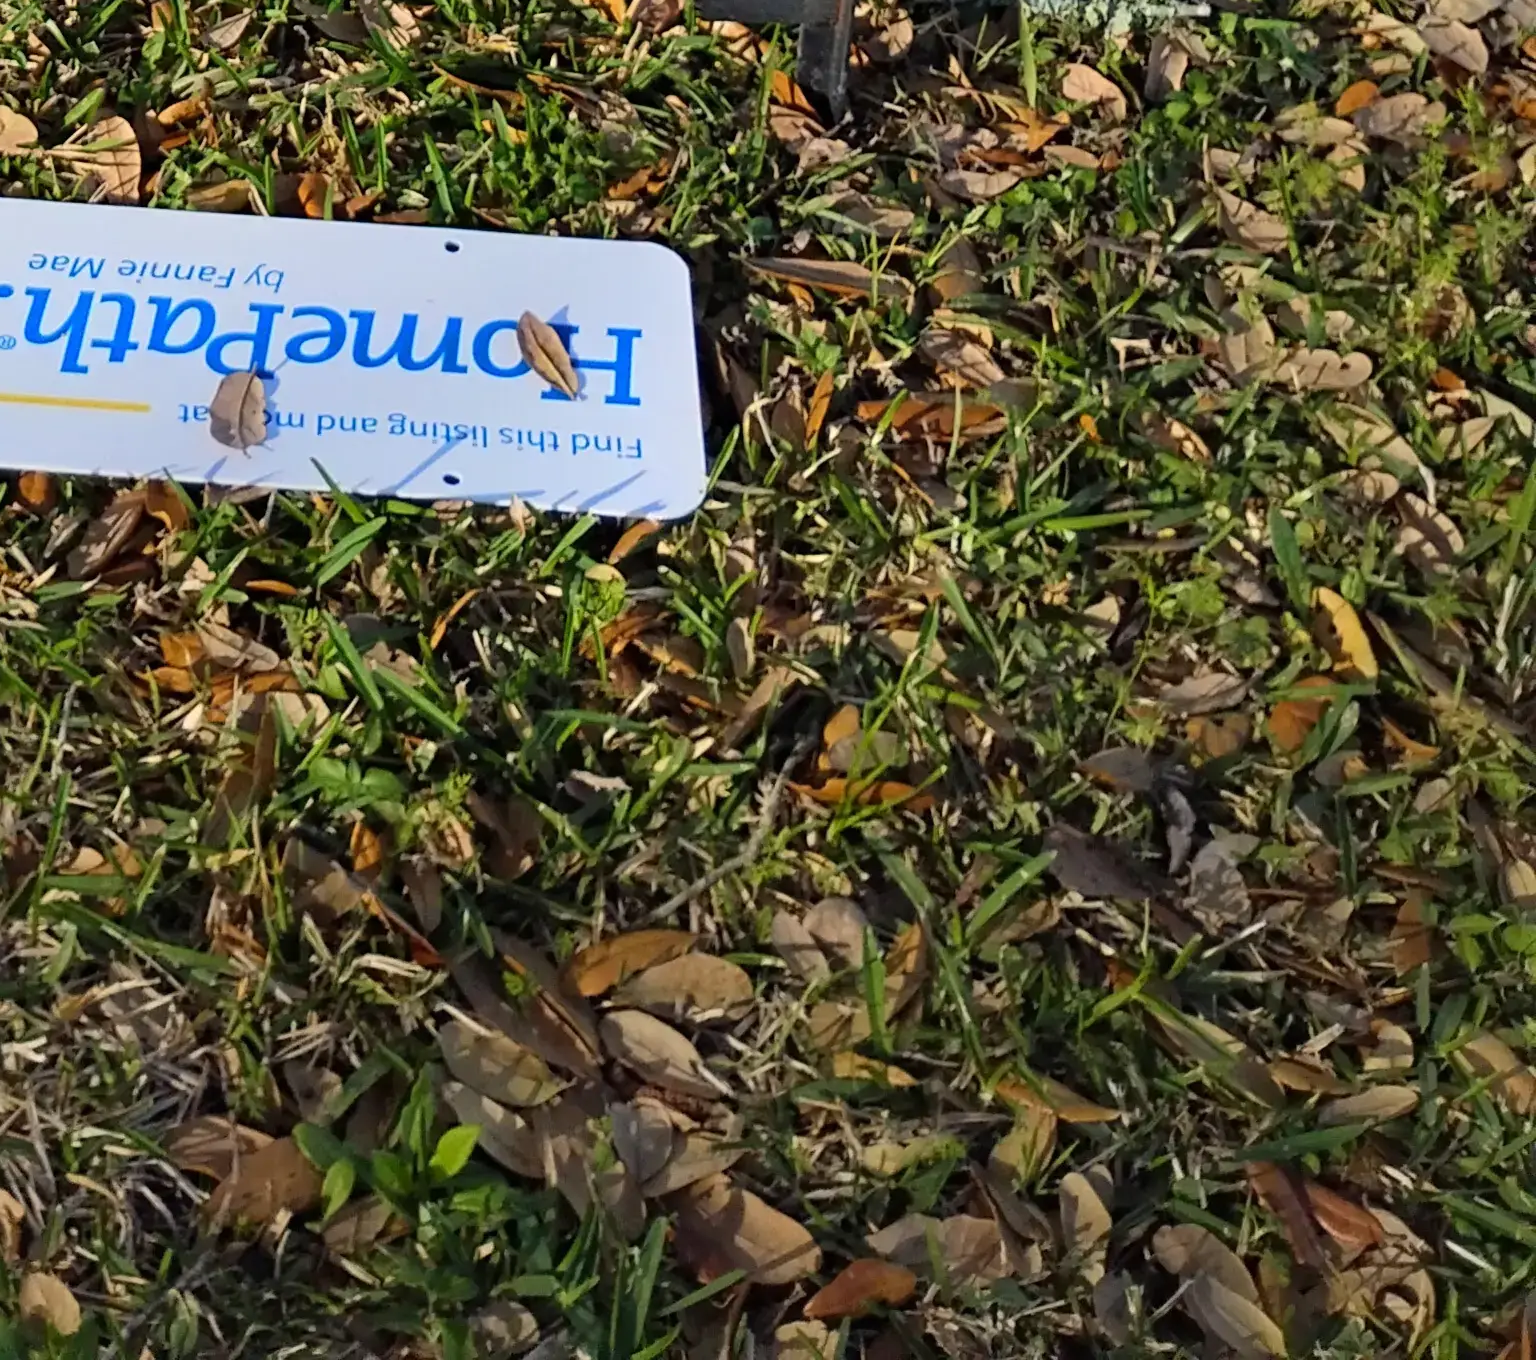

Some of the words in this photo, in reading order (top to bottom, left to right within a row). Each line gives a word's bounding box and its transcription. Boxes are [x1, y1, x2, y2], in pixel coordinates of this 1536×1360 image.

[27, 252, 106, 281] Mae
[117, 258, 236, 290] Fannie
[245, 262, 285, 294] by
[178, 404, 211, 424] at
[317, 414, 377, 437] and
[387, 412, 489, 447] listing
[501, 427, 560, 454] this
[573, 433, 643, 459] Find
